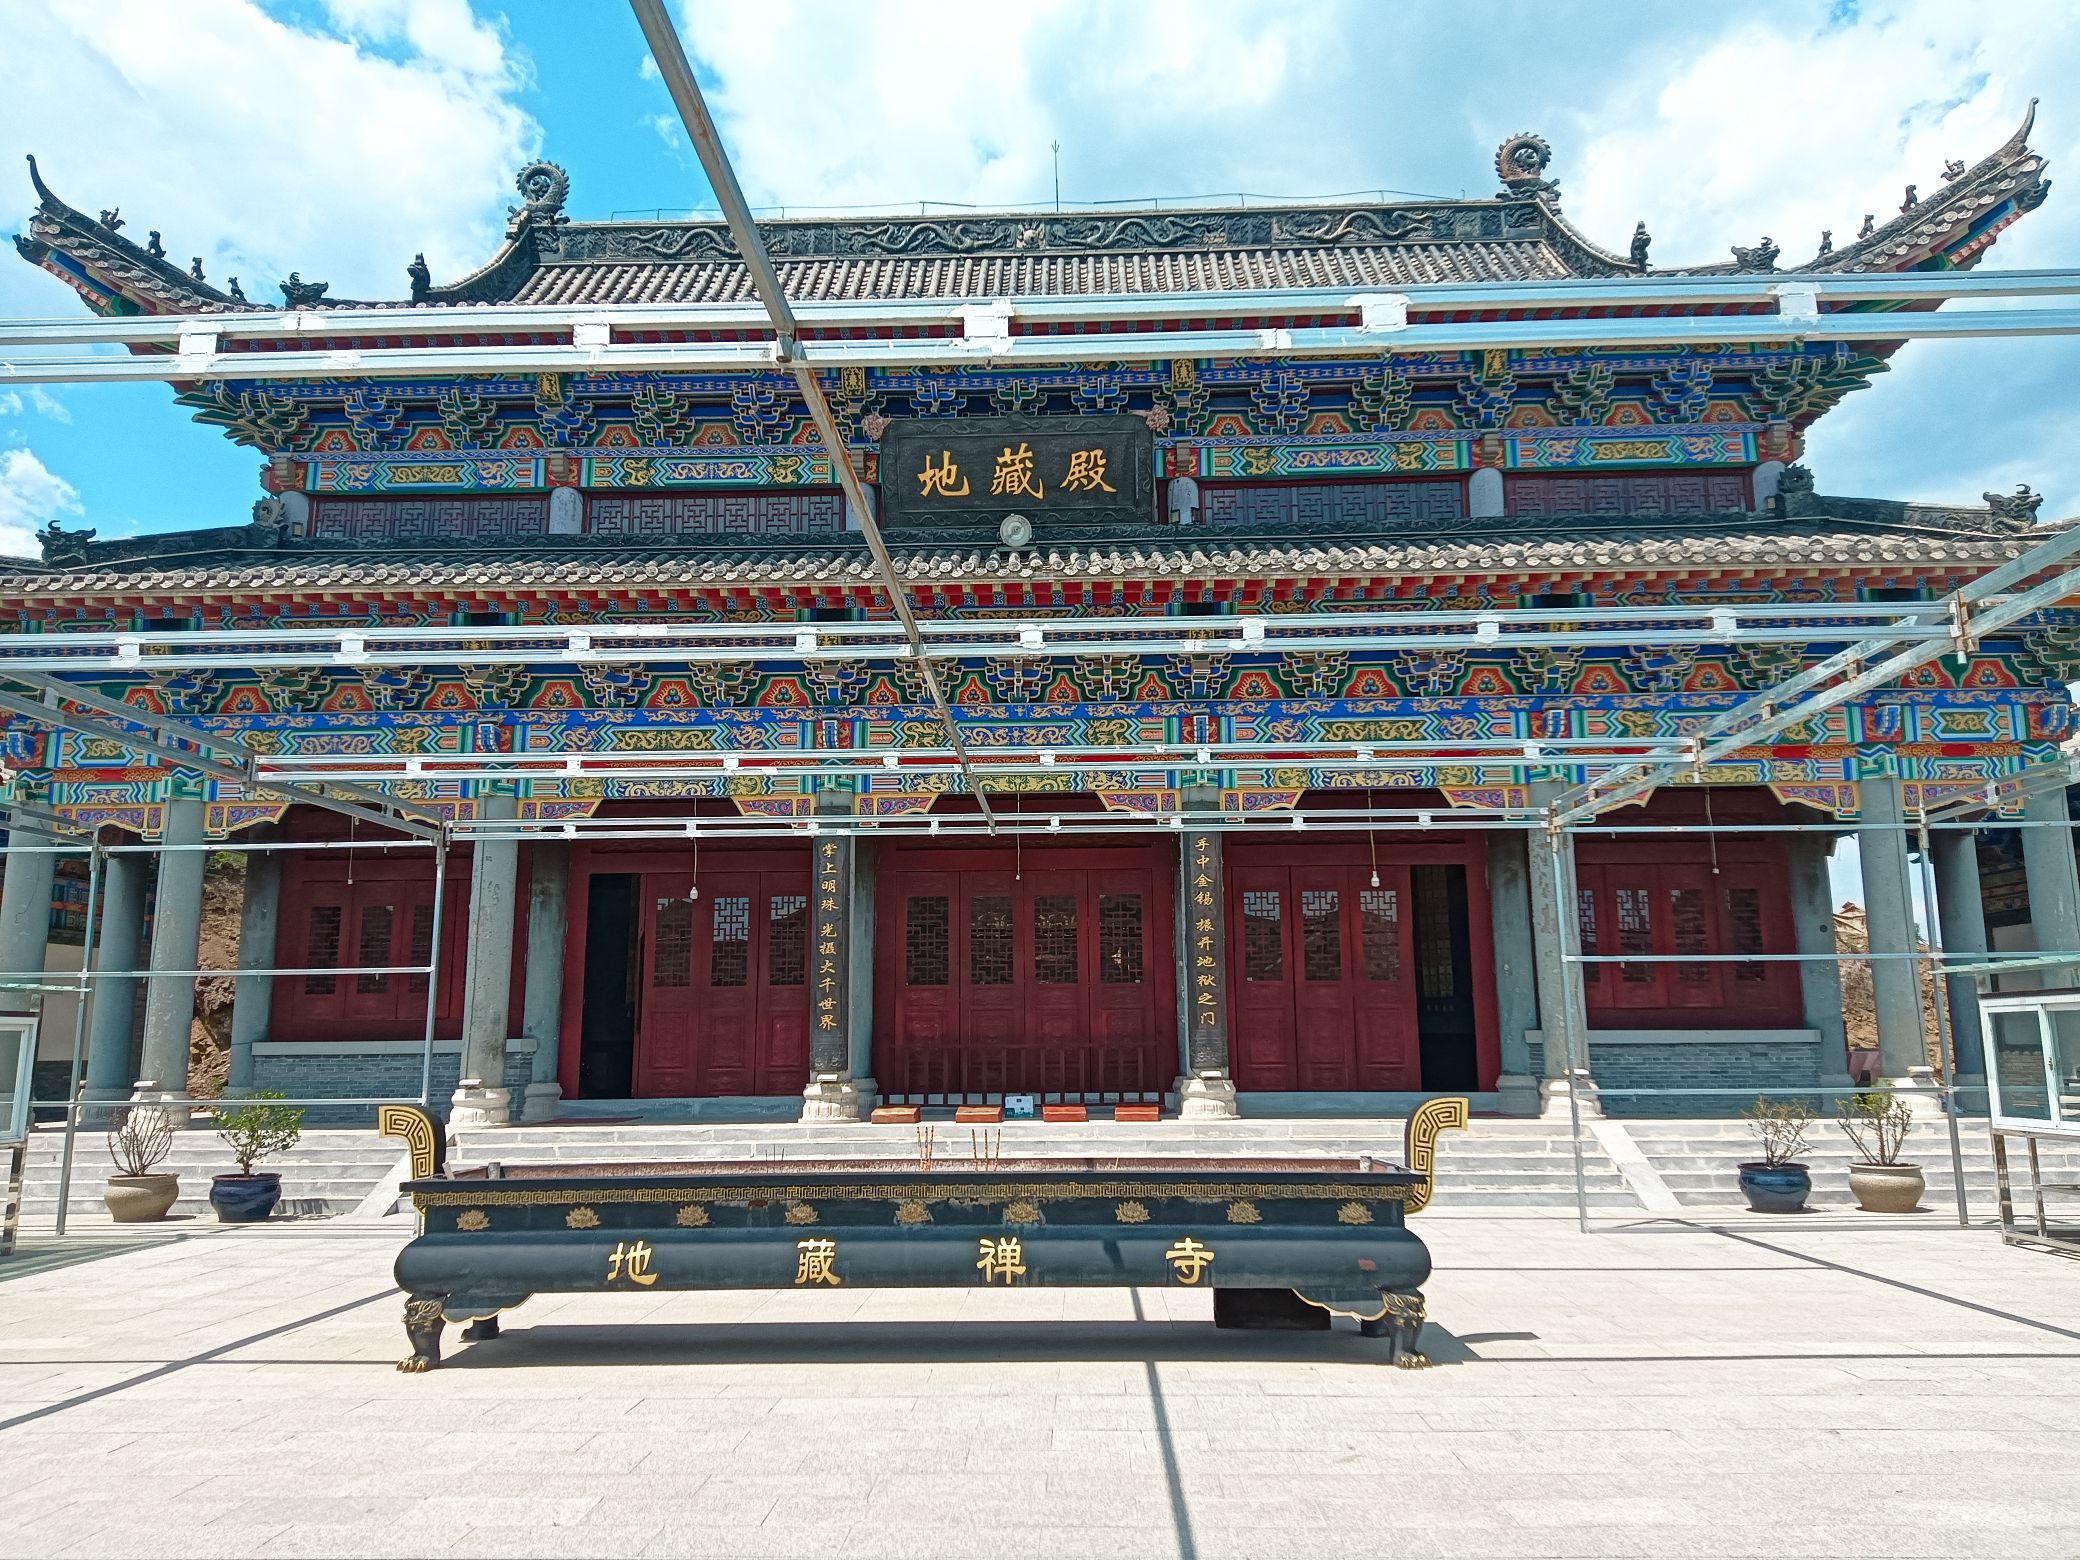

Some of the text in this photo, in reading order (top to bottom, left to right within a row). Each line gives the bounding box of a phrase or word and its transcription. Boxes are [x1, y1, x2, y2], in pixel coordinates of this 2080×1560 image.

[917, 442, 1117, 500] 地藏殿
[607, 1237, 1215, 1285] 地藏禅寺
